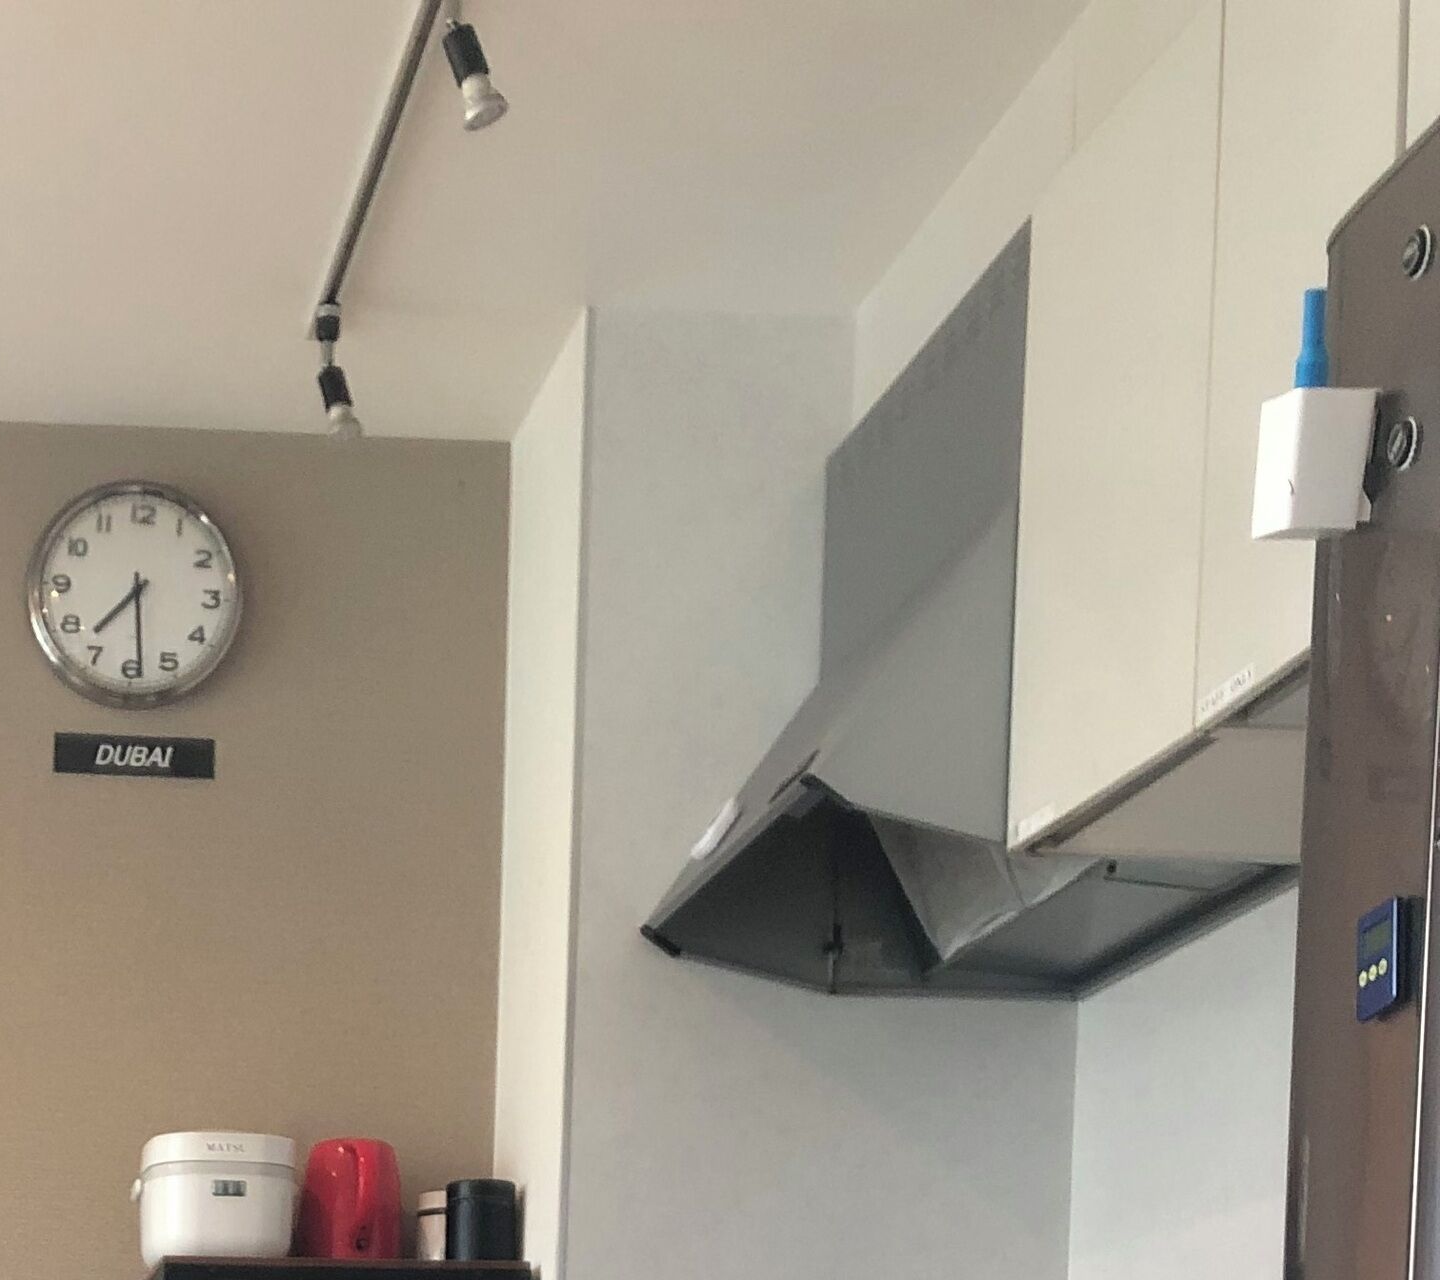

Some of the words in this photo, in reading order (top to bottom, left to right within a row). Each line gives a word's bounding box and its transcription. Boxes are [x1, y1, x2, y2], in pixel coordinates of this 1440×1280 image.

[97, 513, 111, 533] 11
[130, 504, 157, 525] 12
[176, 518, 182, 537] 1
[67, 537, 88, 557] 10
[193, 550, 212, 569] 2
[51, 574, 72, 594] 9
[200, 589, 221, 609] 3
[60, 614, 81, 634] 8
[187, 625, 206, 645] 4
[87, 646, 103, 666] 7
[159, 652, 179, 671] 5
[121, 659, 141, 679] 6
[95, 744, 176, 768] DUBAI
